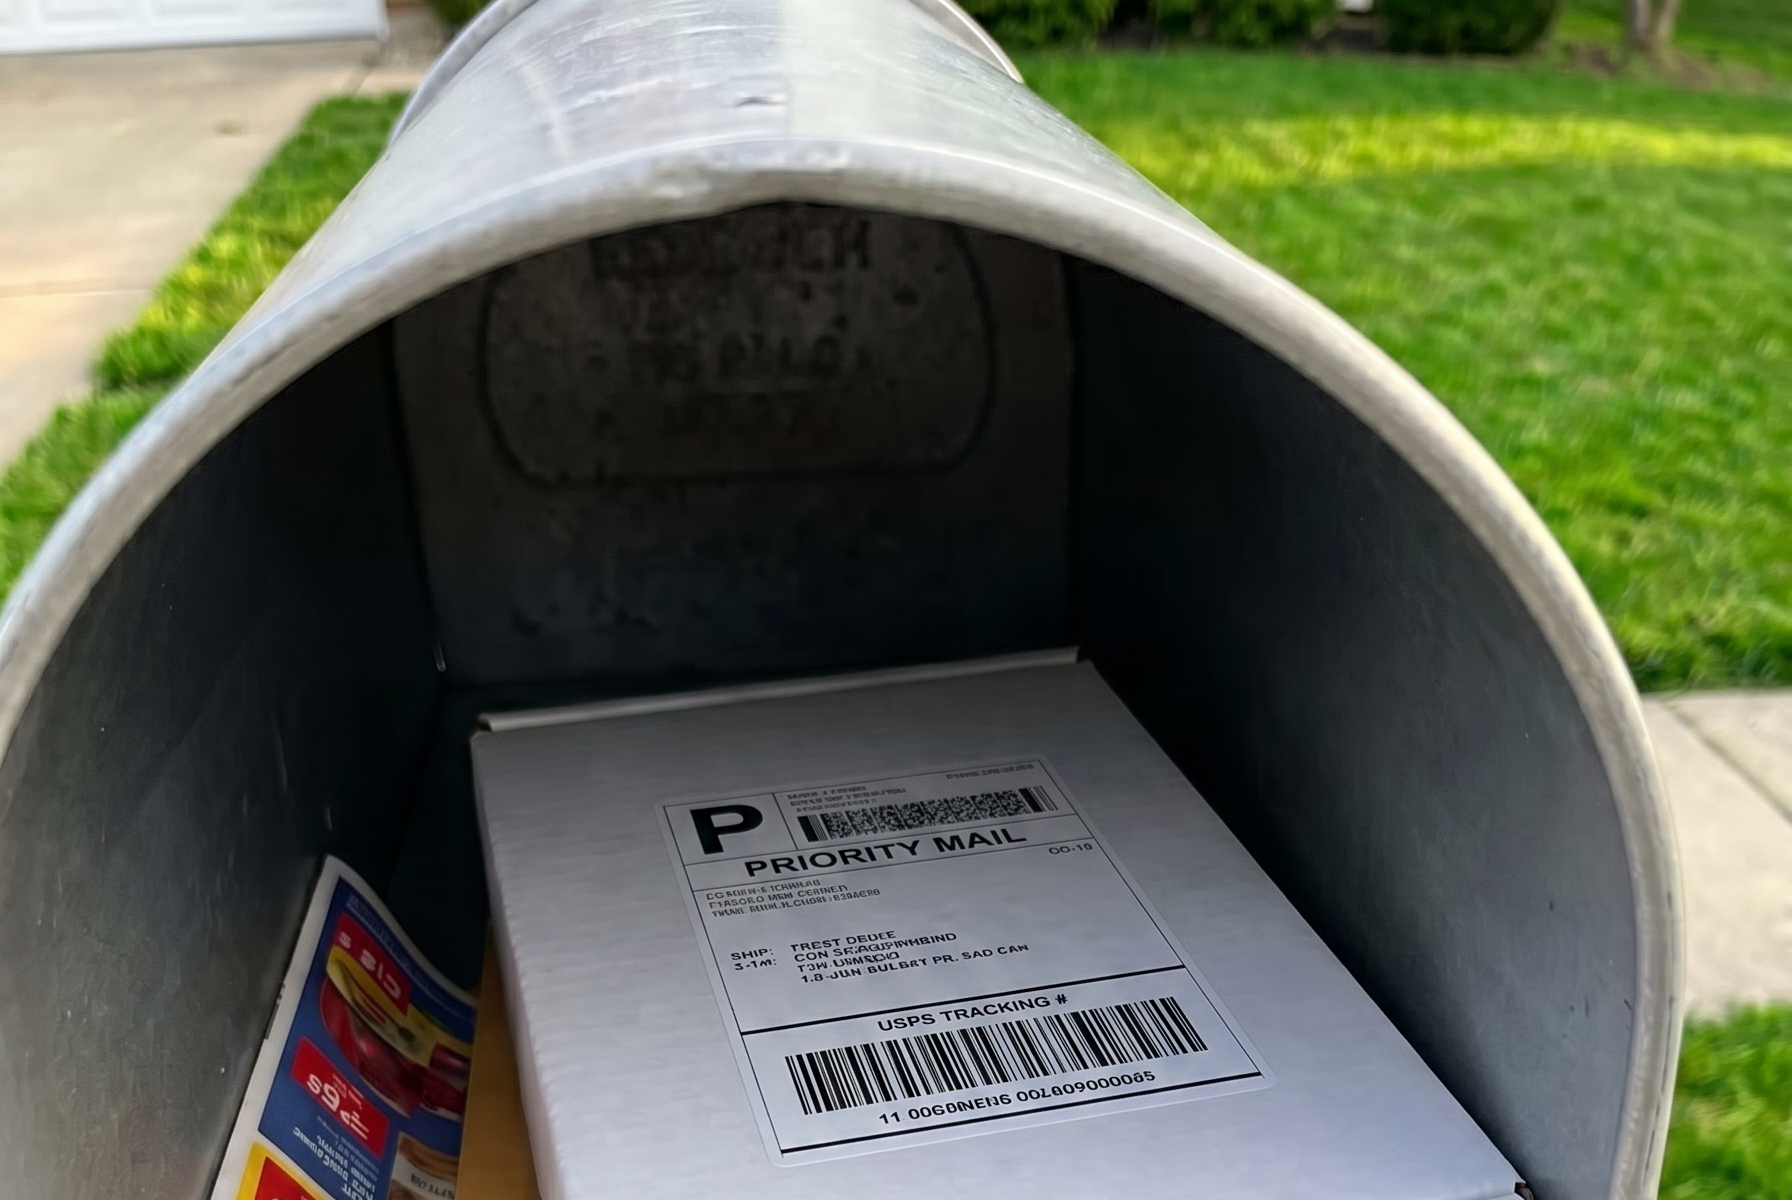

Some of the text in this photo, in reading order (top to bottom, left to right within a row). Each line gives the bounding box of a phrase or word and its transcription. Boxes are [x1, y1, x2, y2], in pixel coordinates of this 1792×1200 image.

[688, 803, 763, 855] P
[744, 828, 1027, 877] PRIORITY MAIL
[730, 948, 773, 961] SHIP:
[789, 937, 841, 952] TREST
[793, 949, 829, 962] CON
[931, 954, 959, 964] PR.
[961, 948, 993, 960] SAD
[877, 993, 1068, 1031] USPS TRACKING #
[878, 1111, 900, 1124] 11
